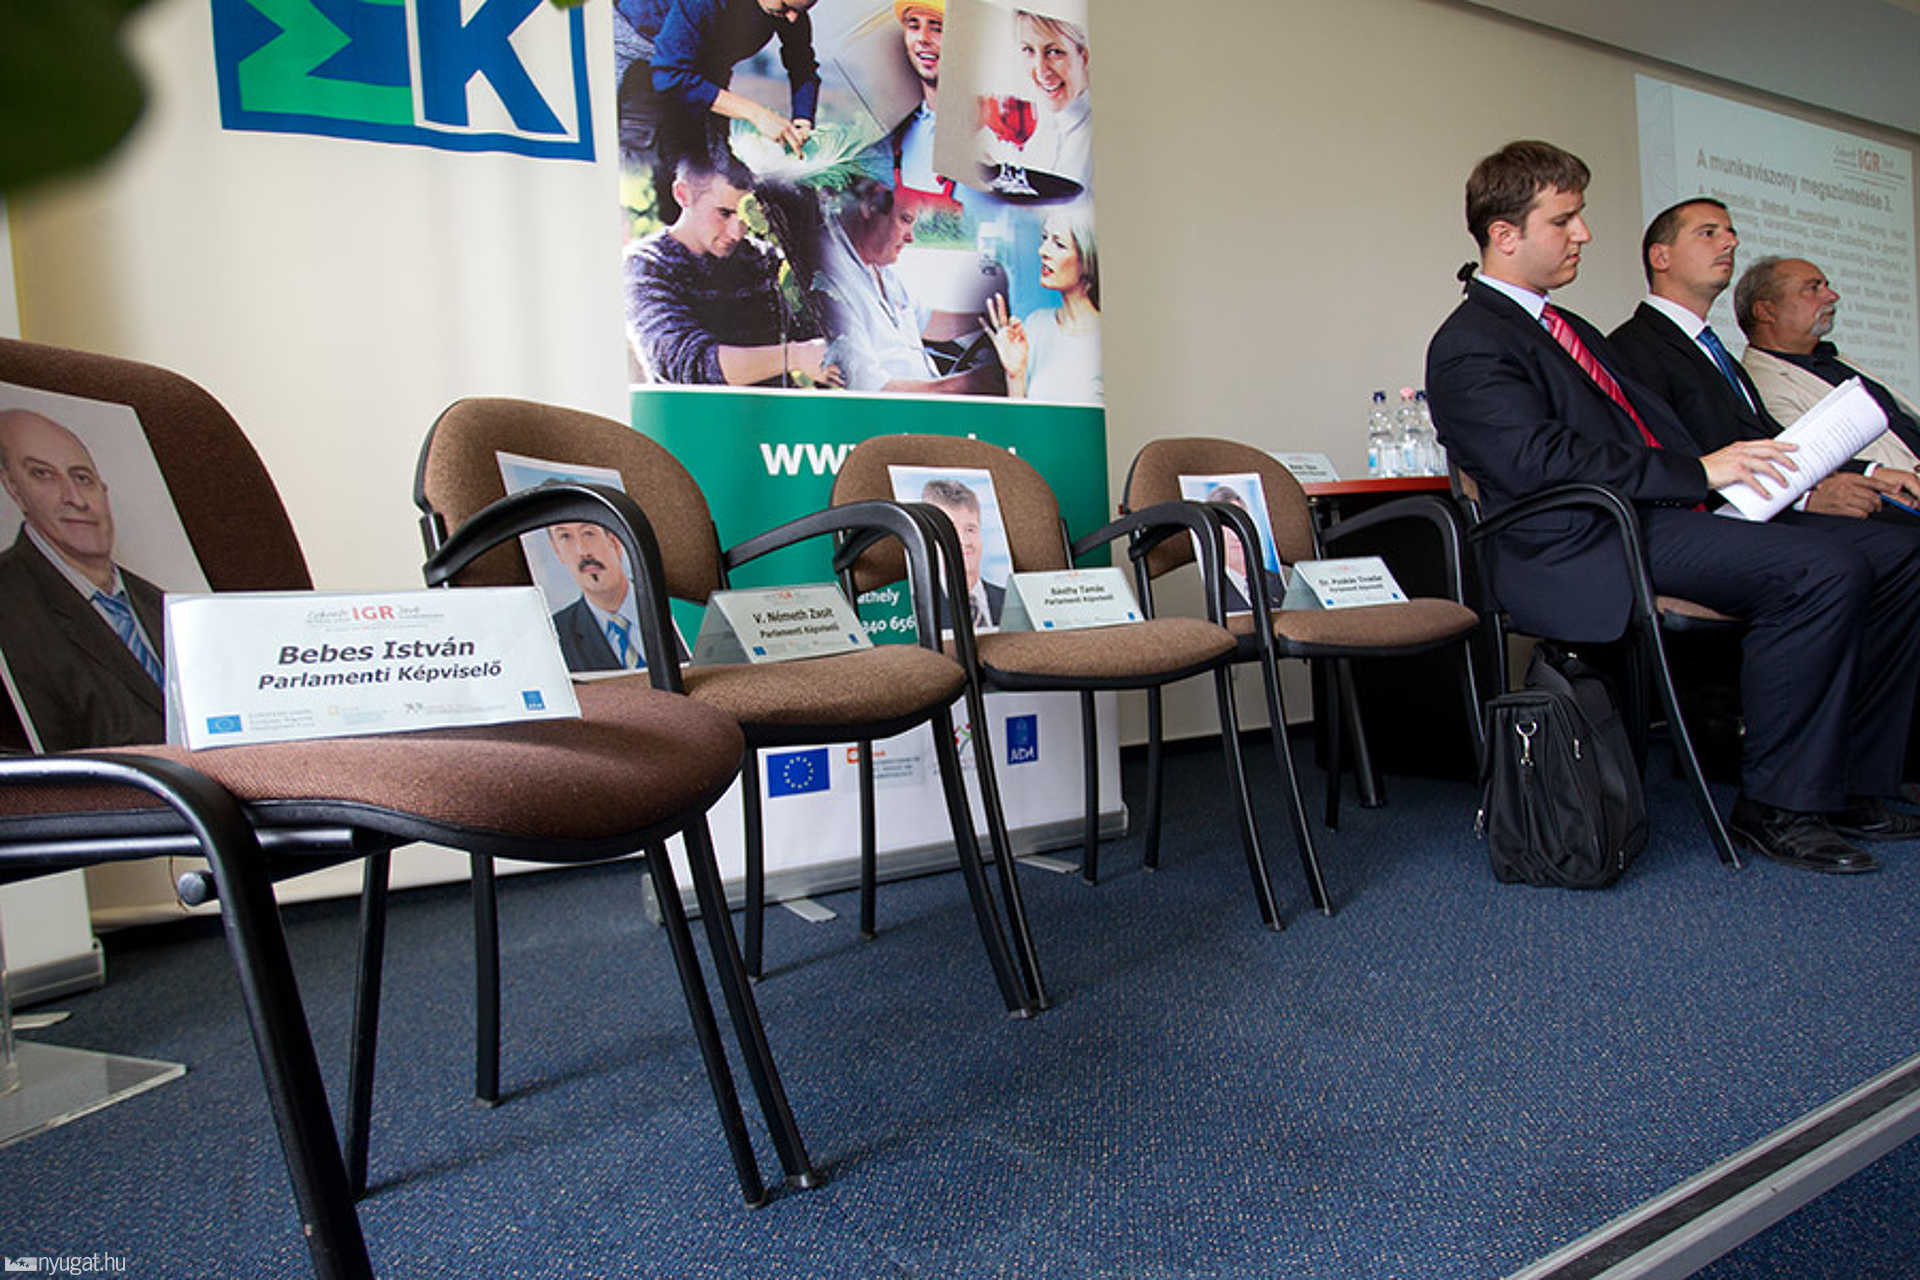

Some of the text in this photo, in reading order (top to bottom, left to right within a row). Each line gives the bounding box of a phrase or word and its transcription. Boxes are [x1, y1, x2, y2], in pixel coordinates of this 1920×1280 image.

[1697, 149, 1707, 169] A
[352, 605, 395, 621] IGR
[278, 636, 475, 666] Bebes István
[258, 660, 502, 691] Parlamenti Képviselő
